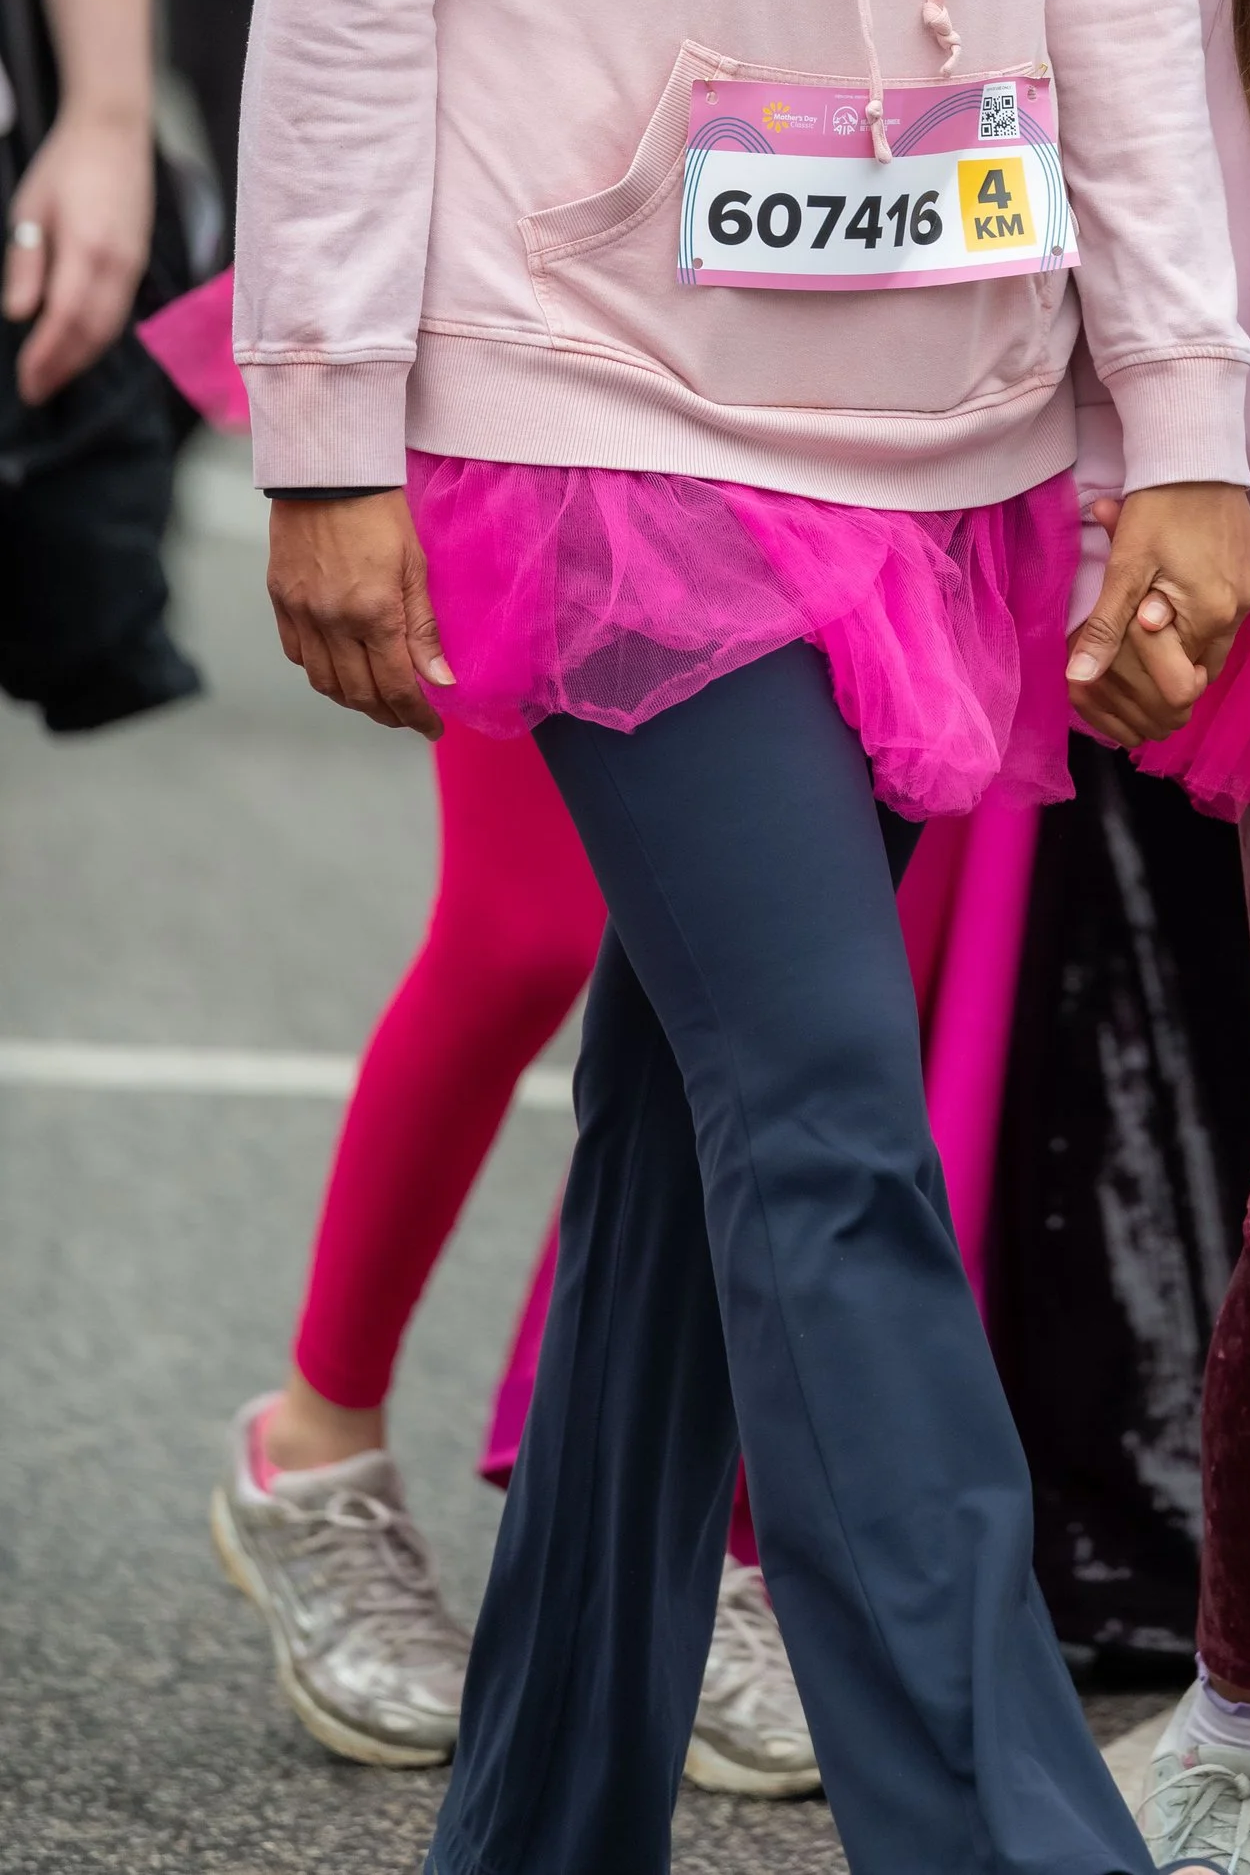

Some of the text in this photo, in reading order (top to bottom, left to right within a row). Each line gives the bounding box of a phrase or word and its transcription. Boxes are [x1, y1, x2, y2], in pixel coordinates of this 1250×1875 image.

[773, 113, 818, 124] Mother's Day
[790, 121, 815, 129] Classic
[833, 124, 856, 135] AIA
[708, 169, 1013, 250] 607416 4
[974, 212, 1025, 241] KM
